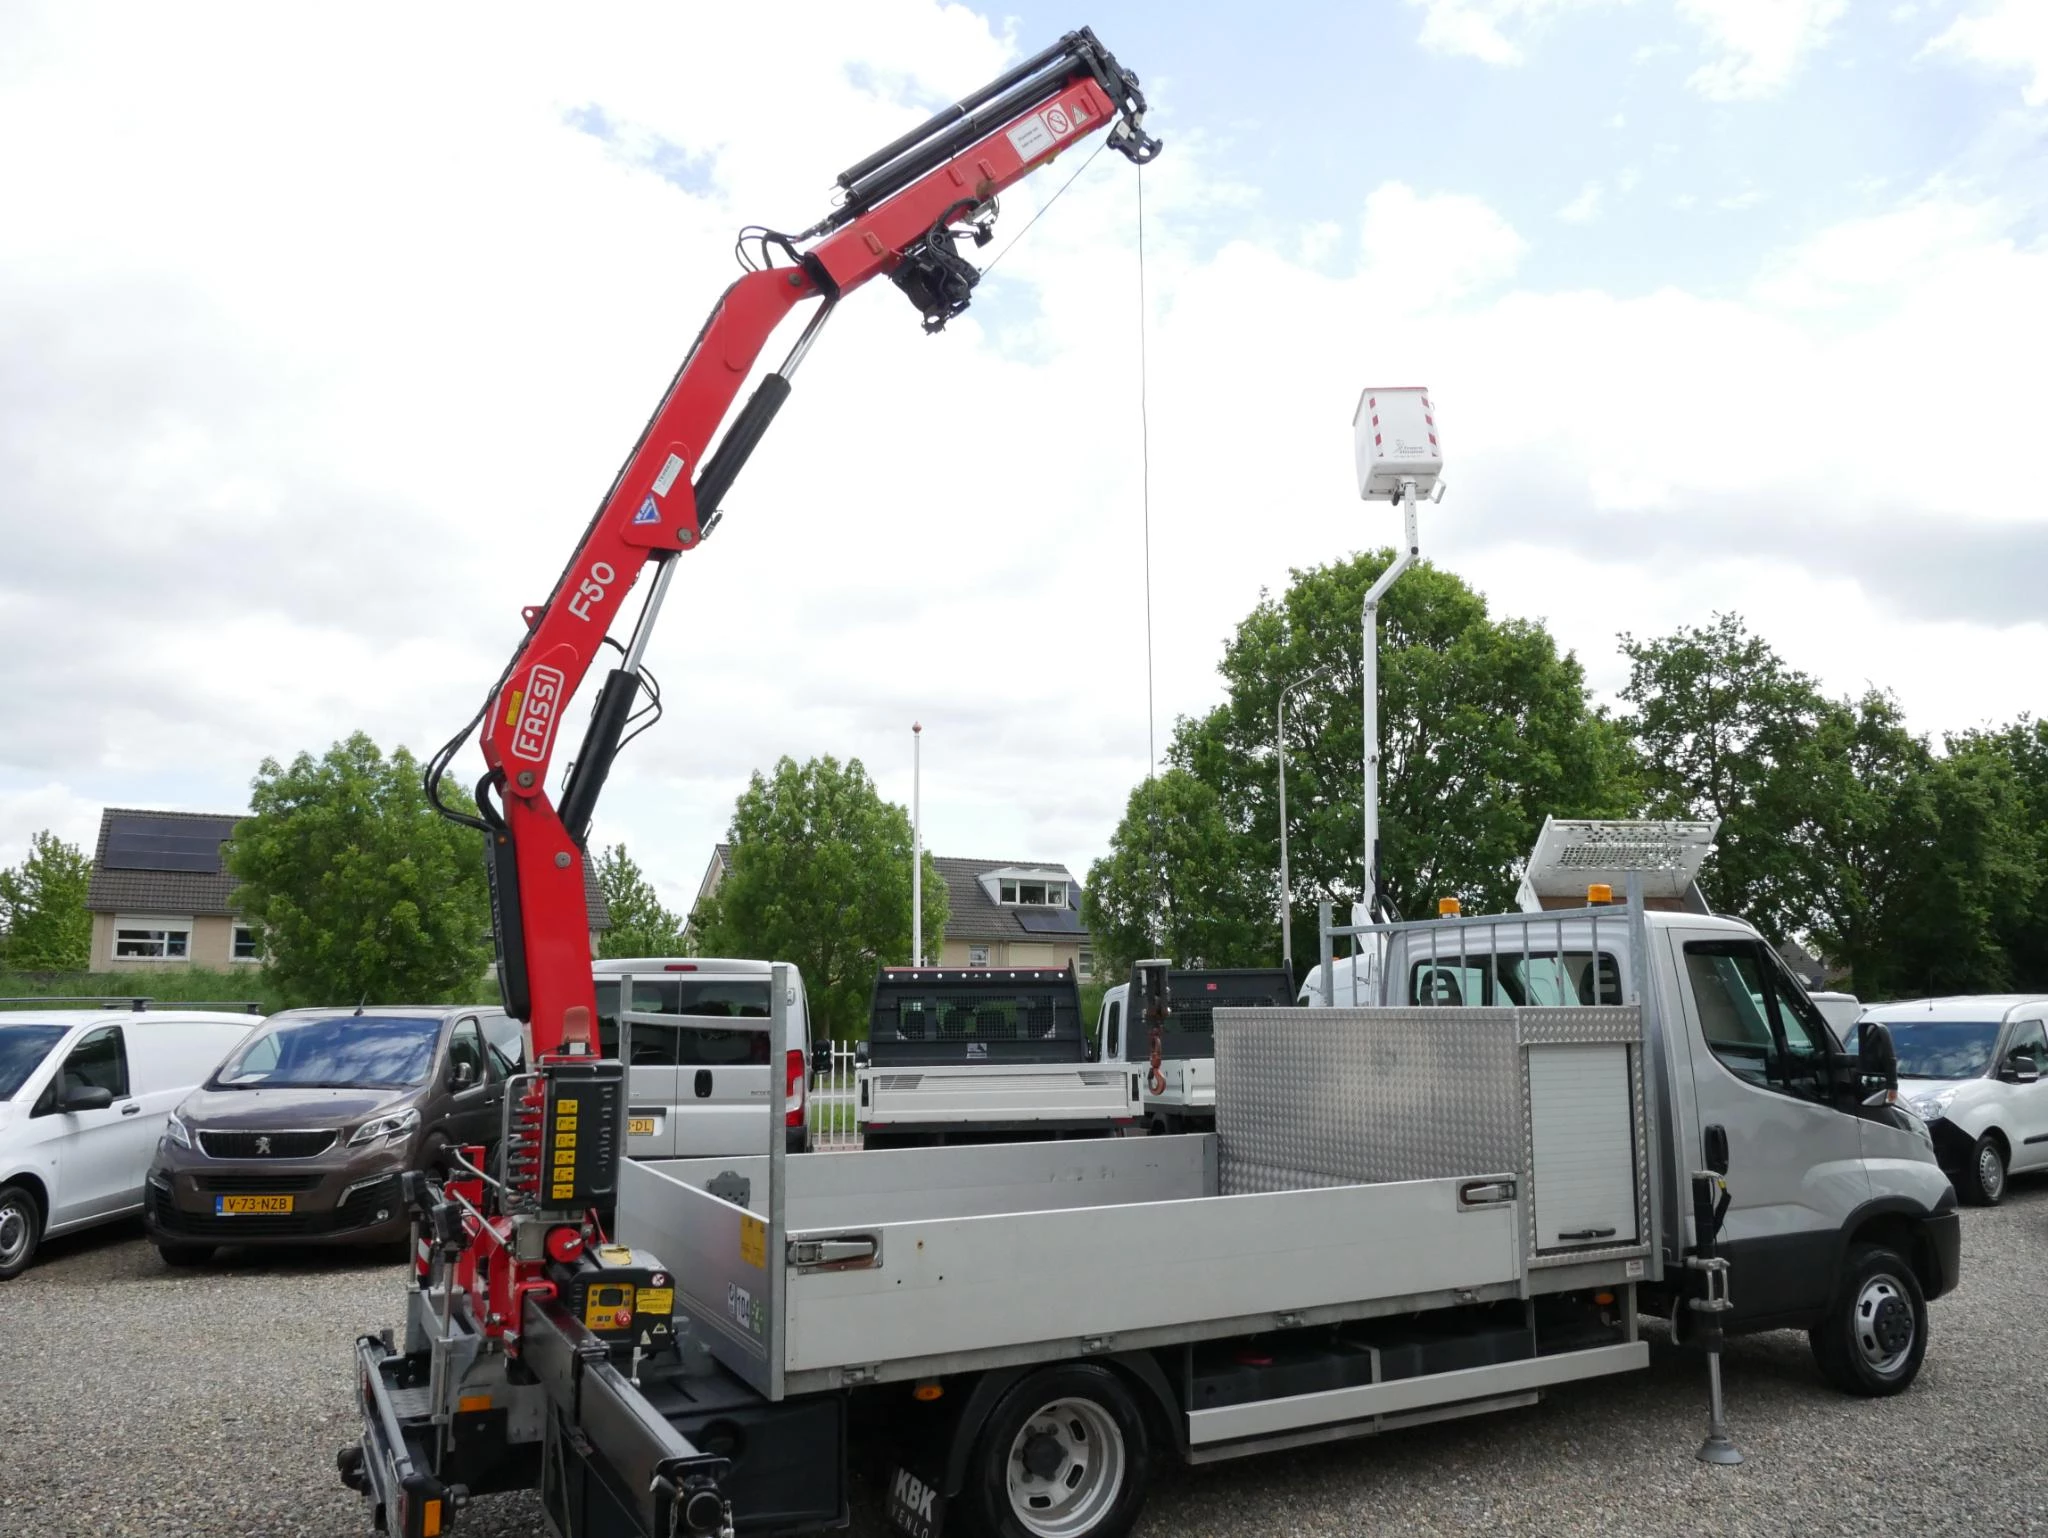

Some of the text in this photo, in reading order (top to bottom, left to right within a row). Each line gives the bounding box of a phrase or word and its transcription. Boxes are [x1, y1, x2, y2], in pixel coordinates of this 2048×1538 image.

[568, 561, 615, 622] F50
[519, 673, 557, 752] FASSI
[228, 1198, 287, 1210] V-73-NZB
[894, 1467, 937, 1523] KBK
